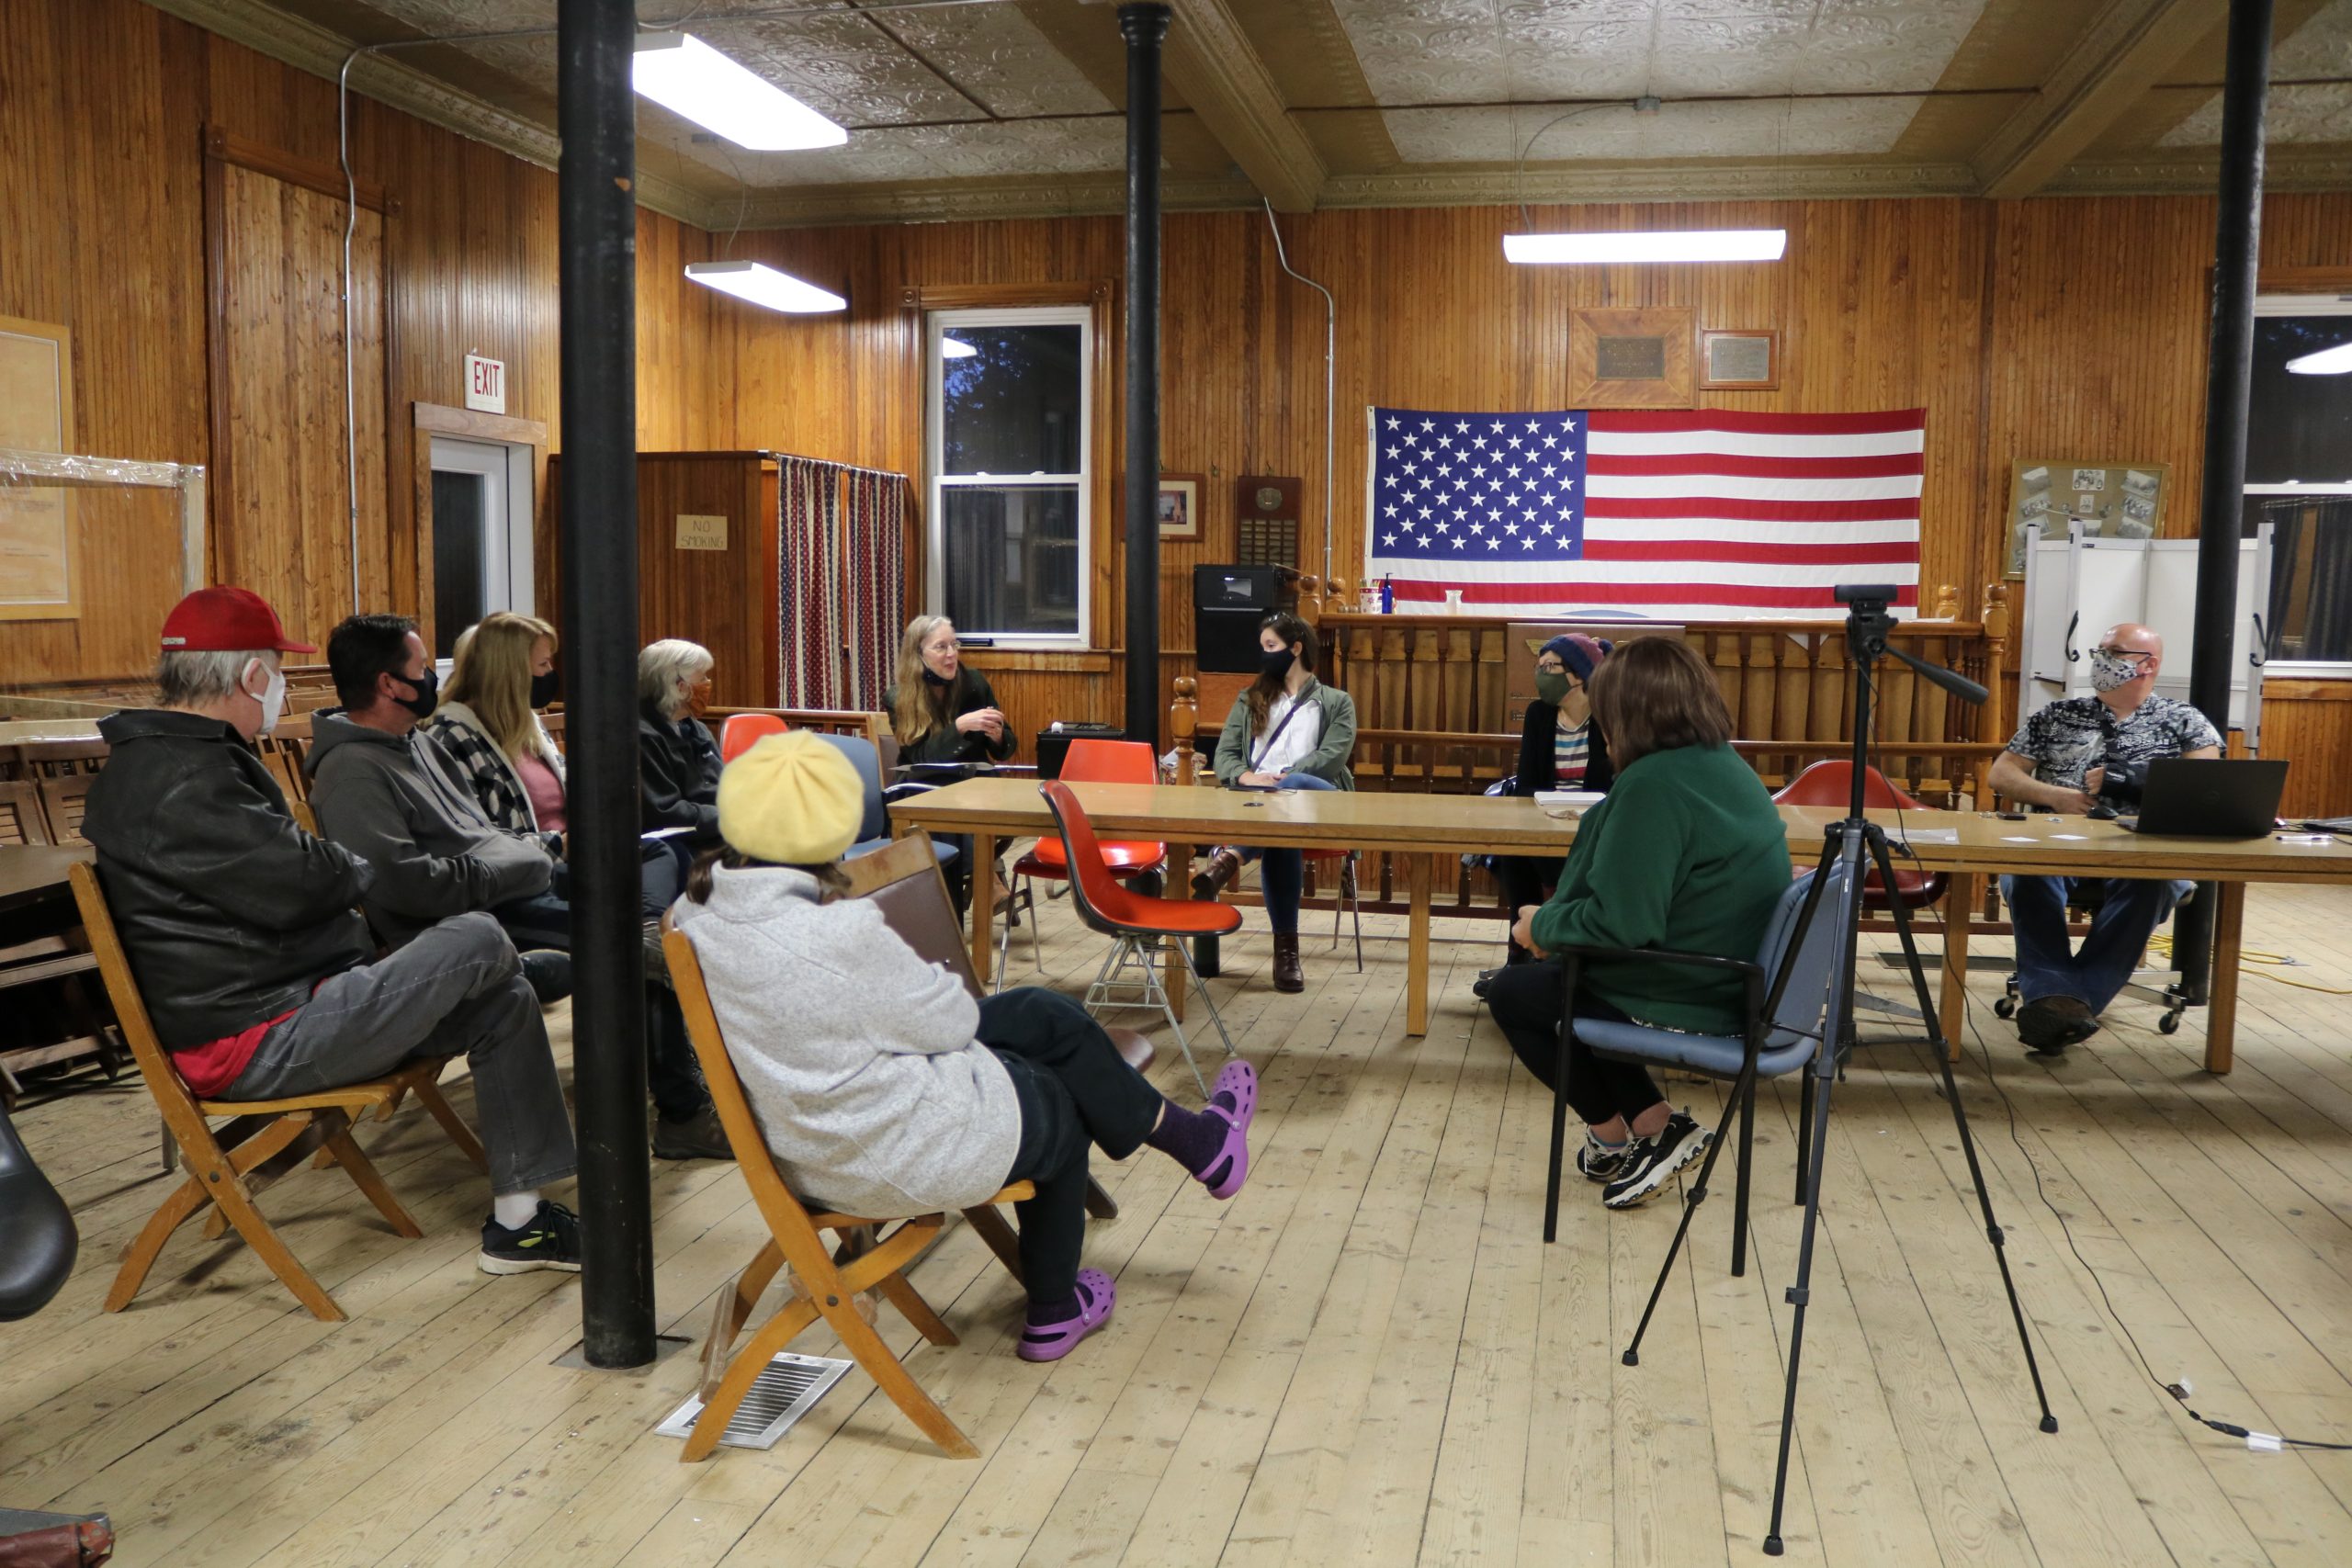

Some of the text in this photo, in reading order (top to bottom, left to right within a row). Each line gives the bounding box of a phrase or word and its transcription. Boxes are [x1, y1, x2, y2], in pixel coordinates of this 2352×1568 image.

[474, 361, 500, 397] EXIT
[693, 520, 711, 533] NO
[681, 536, 724, 548] SMOKING
